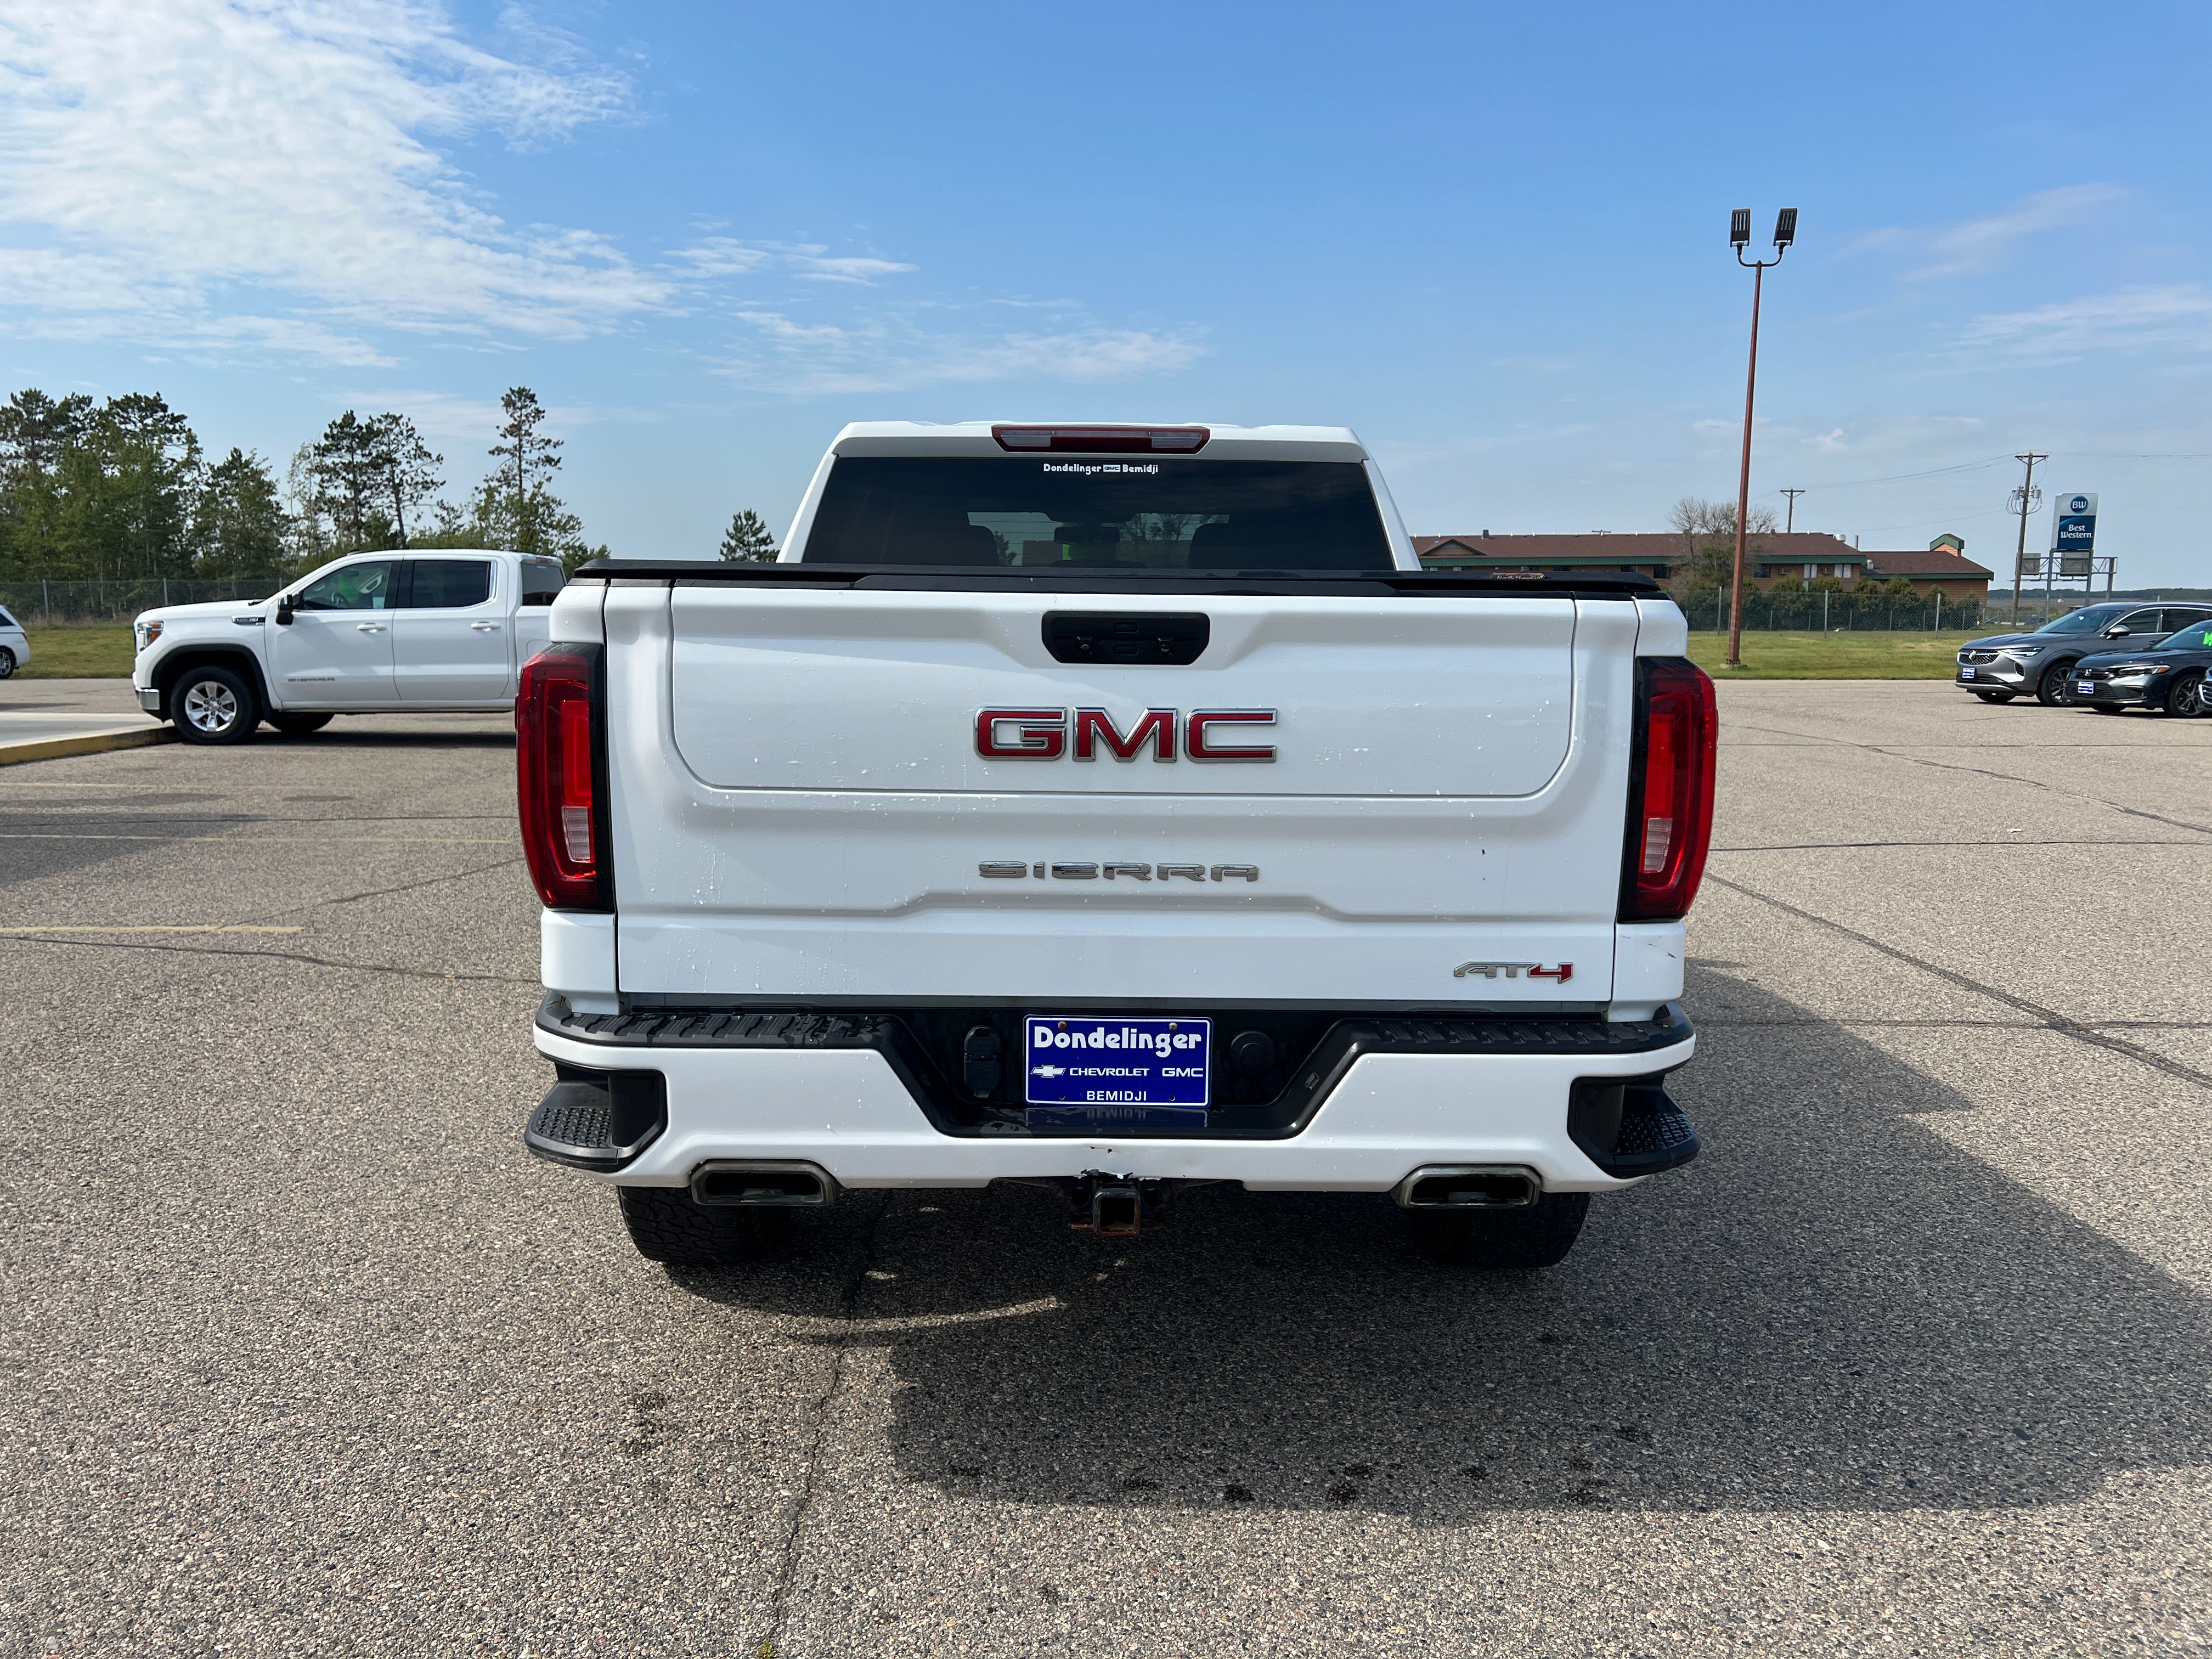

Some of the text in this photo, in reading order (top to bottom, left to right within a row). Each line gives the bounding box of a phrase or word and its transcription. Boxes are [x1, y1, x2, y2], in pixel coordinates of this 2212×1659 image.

[1043, 463, 1102, 475] Dondelinger
[1122, 464, 1158, 475] Bemidji
[973, 706, 1278, 763] GMC
[978, 861, 1259, 882] SIERRA
[1454, 961, 1573, 984] AT4
[1034, 1026, 1201, 1058] Dondelinger
[1070, 1068, 1204, 1077] CHEVROLET GMC
[1087, 1090, 1147, 1101] BEMIDJI
